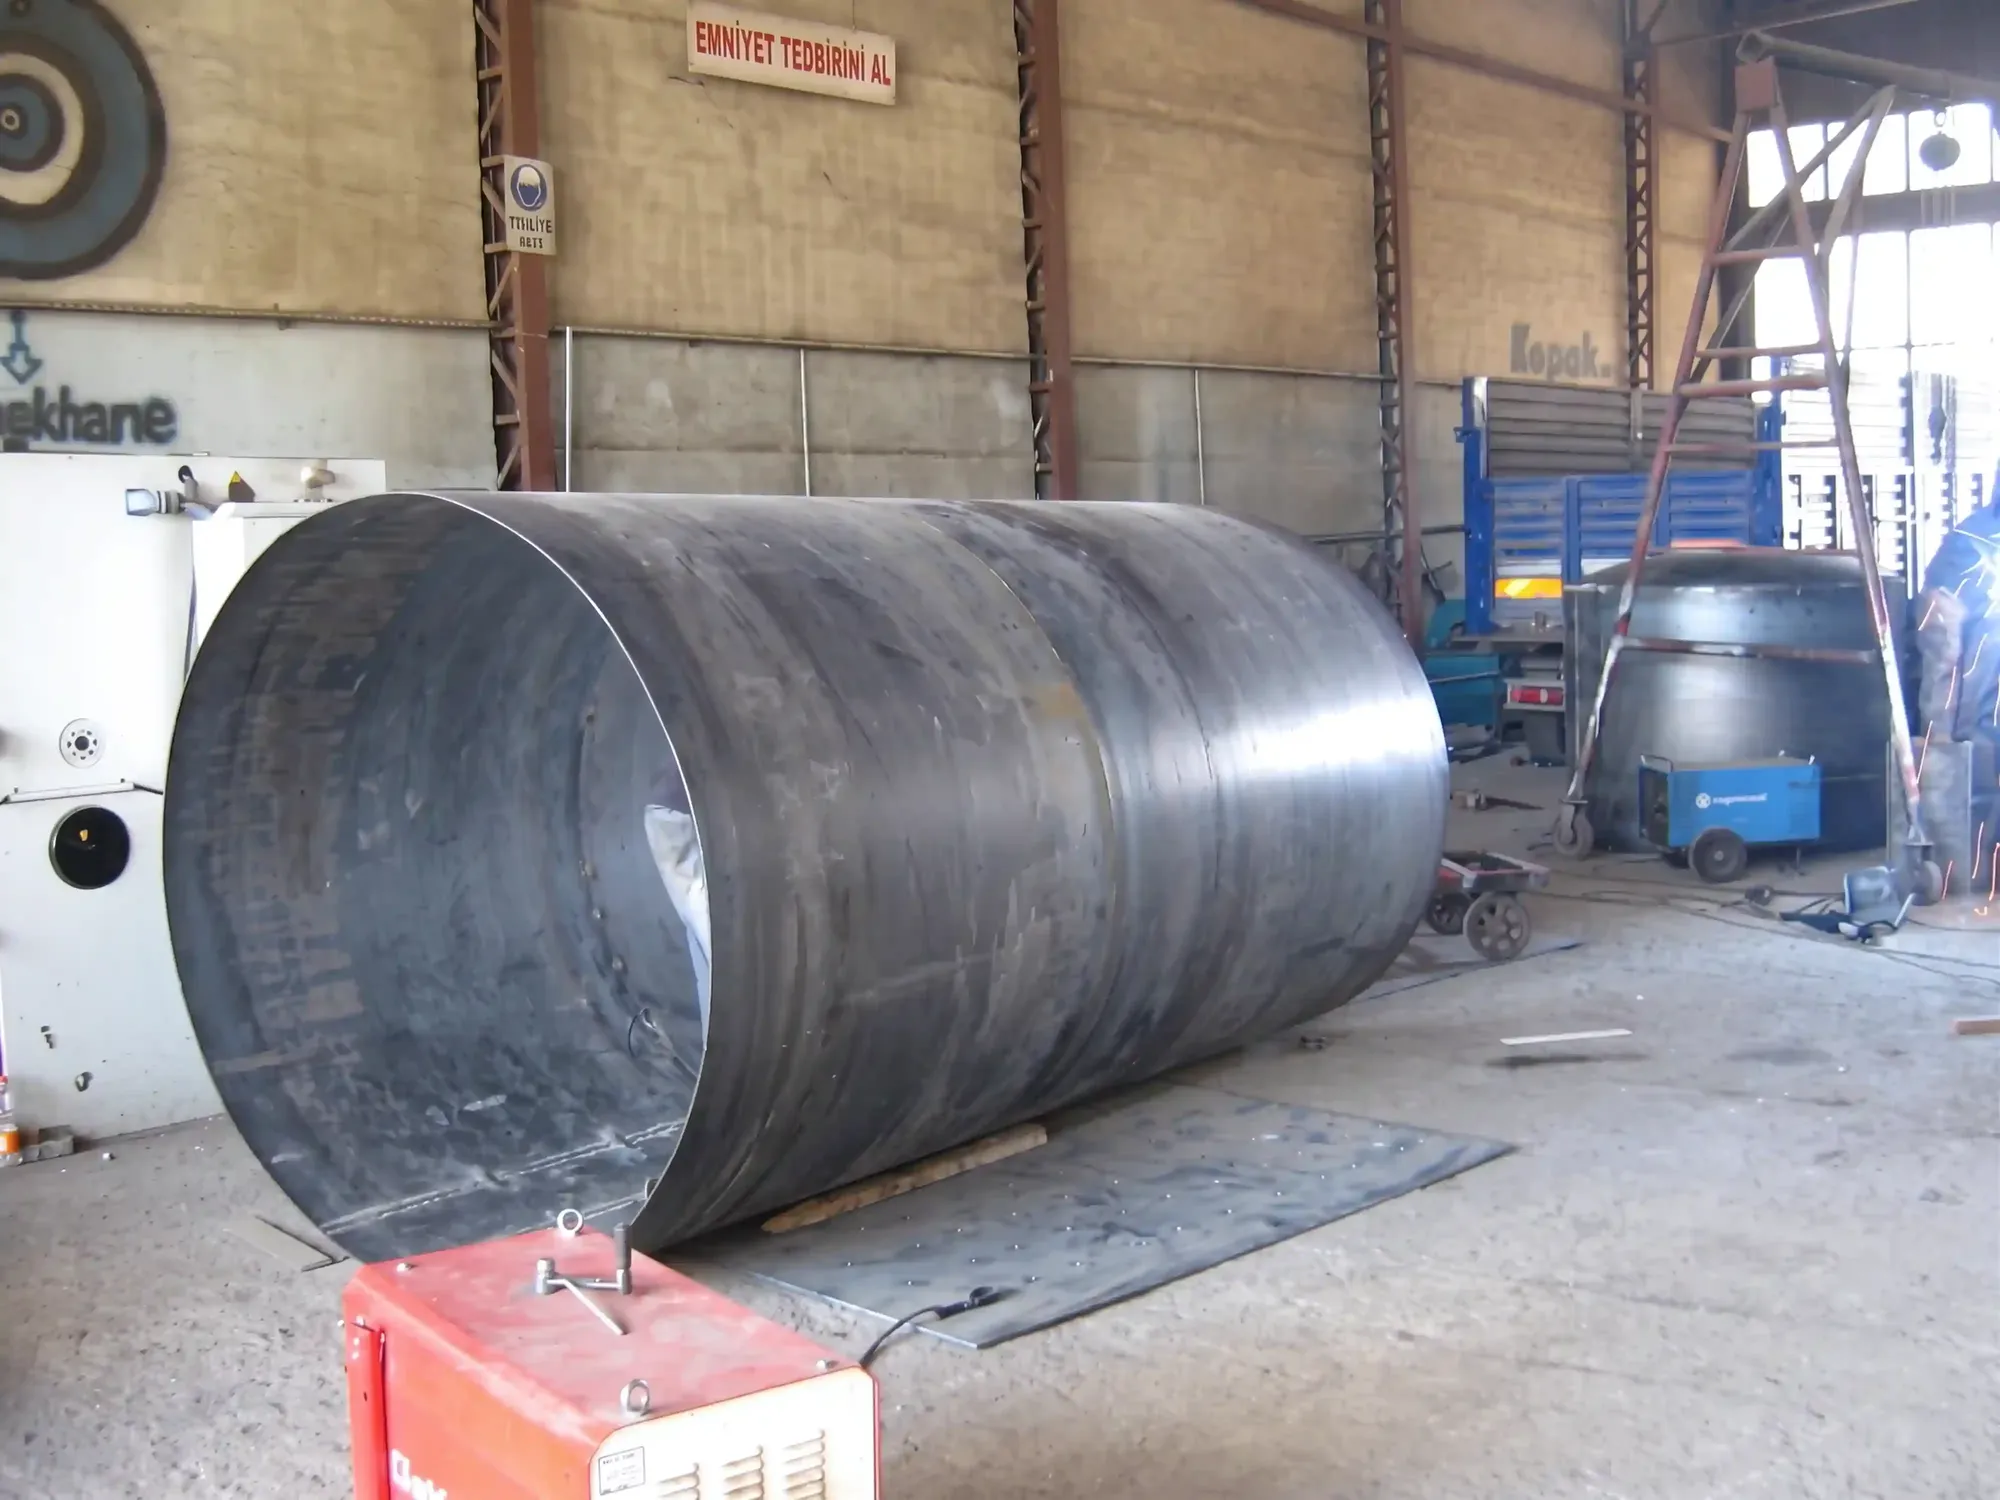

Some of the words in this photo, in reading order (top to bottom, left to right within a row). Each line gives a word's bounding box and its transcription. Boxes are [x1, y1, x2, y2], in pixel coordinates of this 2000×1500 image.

[695, 20, 775, 65] EMNİYET
[780, 37, 865, 82] TEDBİRİNİ
[871, 53, 891, 86] AL
[0, 385, 178, 444] ekhane
